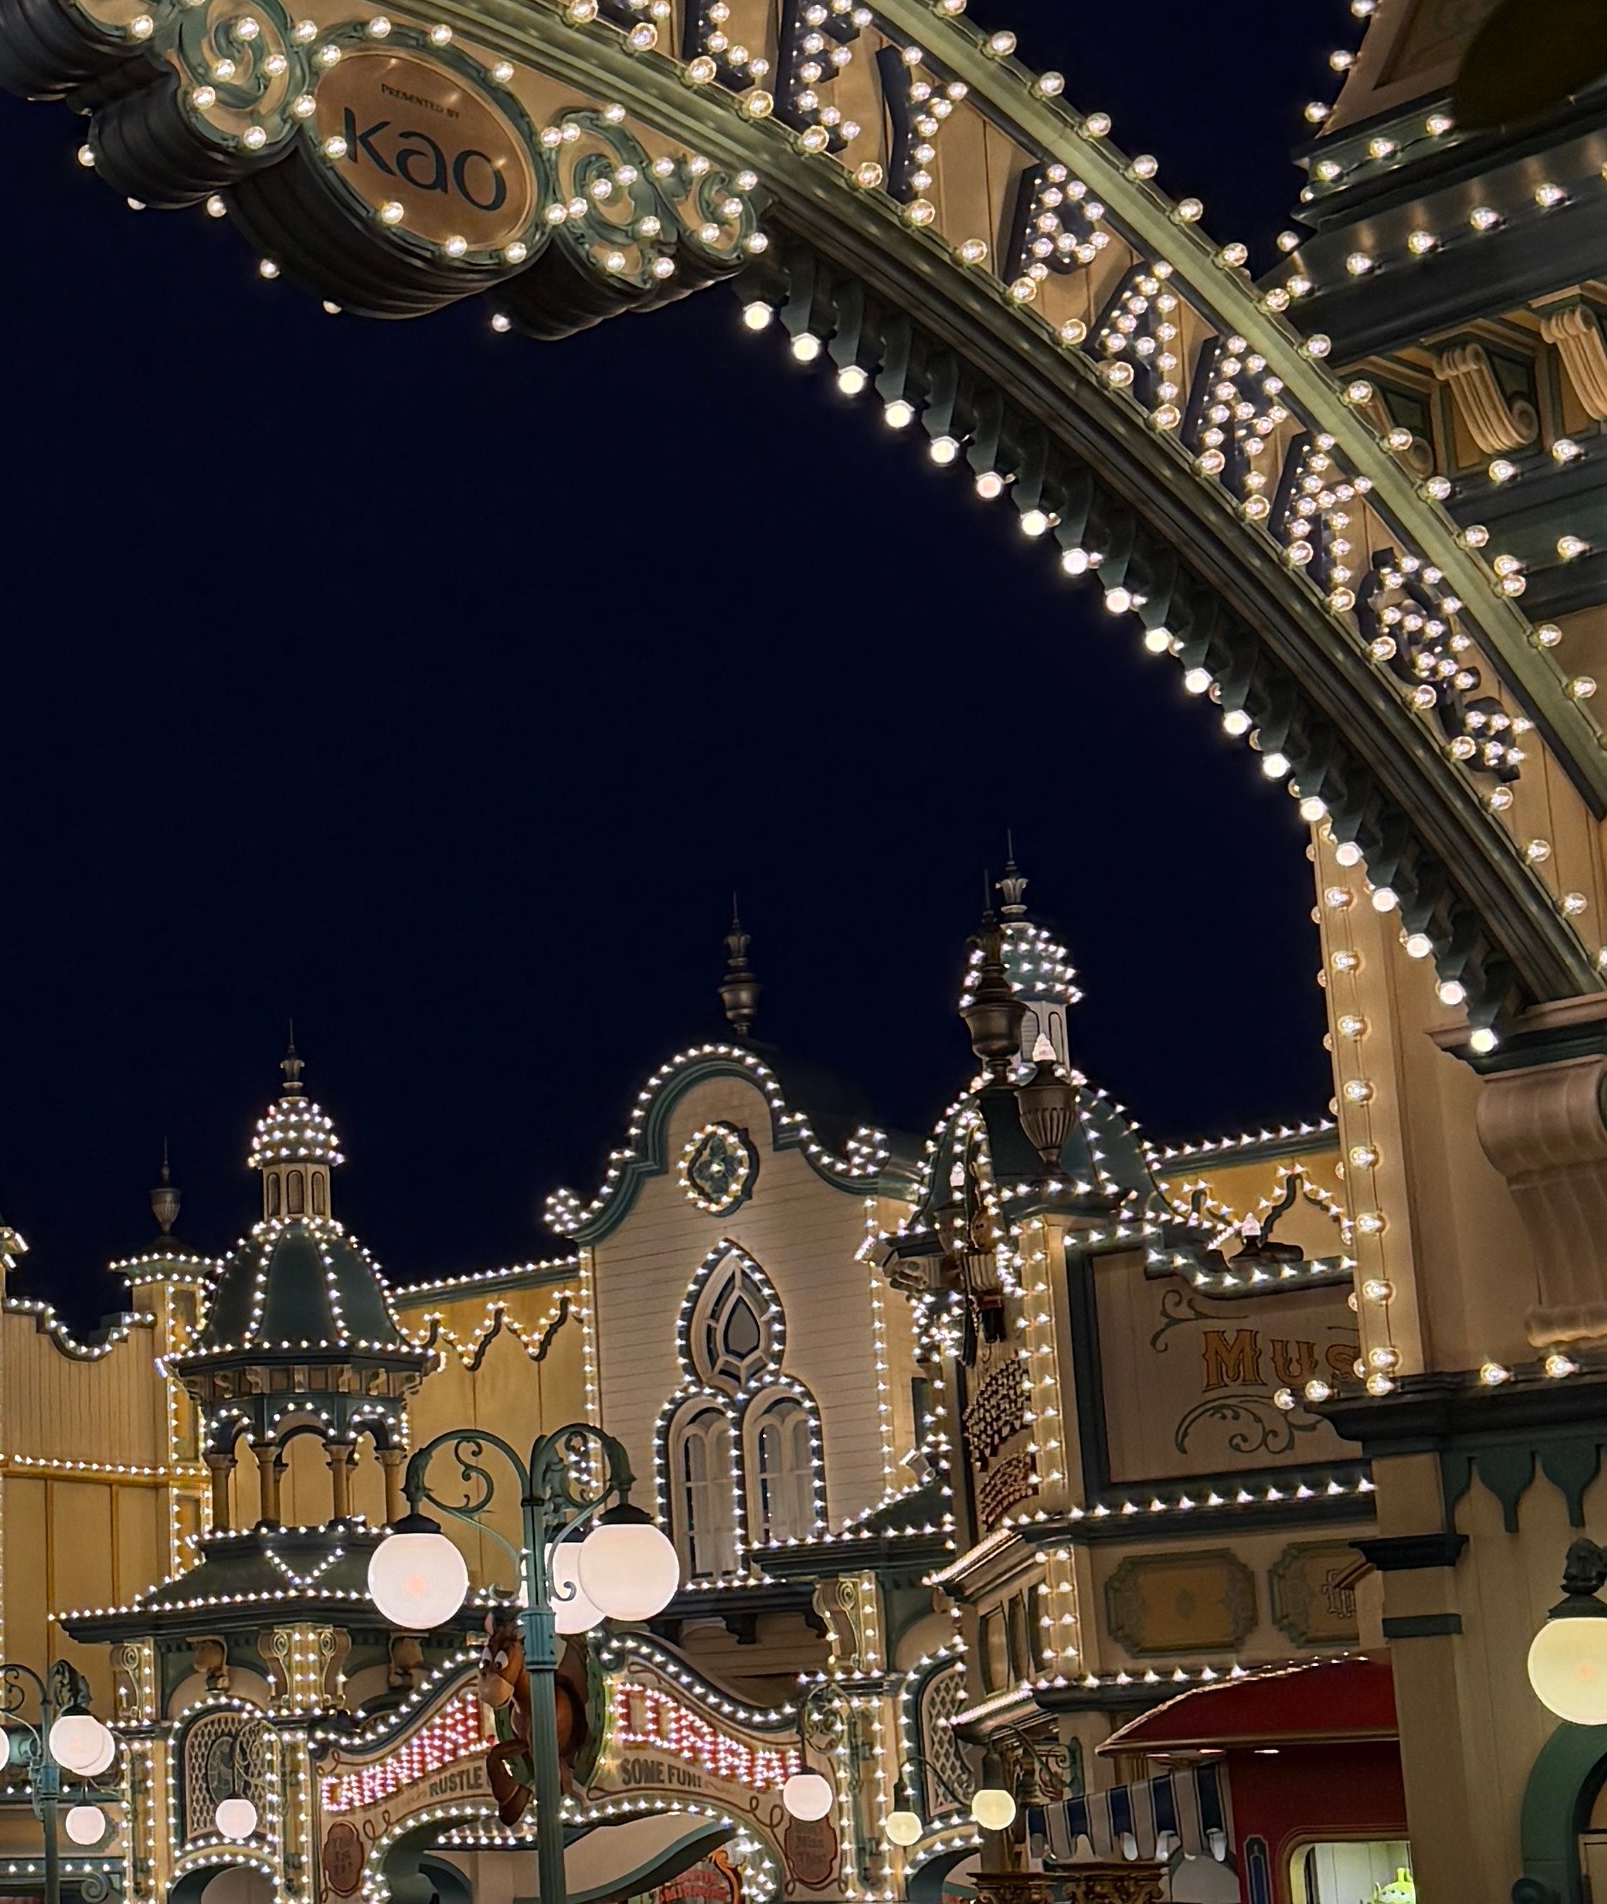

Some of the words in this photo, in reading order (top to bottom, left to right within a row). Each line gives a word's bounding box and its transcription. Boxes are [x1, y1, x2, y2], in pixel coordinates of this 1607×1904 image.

[381, 83, 444, 114] PRESENTED
[446, 106, 460, 120] BY
[1004, 160, 1374, 602] PARK
[321, 1692, 499, 1813] CARNIVAL
[429, 1766, 483, 1797] RUSTLE
[620, 1757, 664, 1786] SOME
[667, 1765, 702, 1788] FUN!
